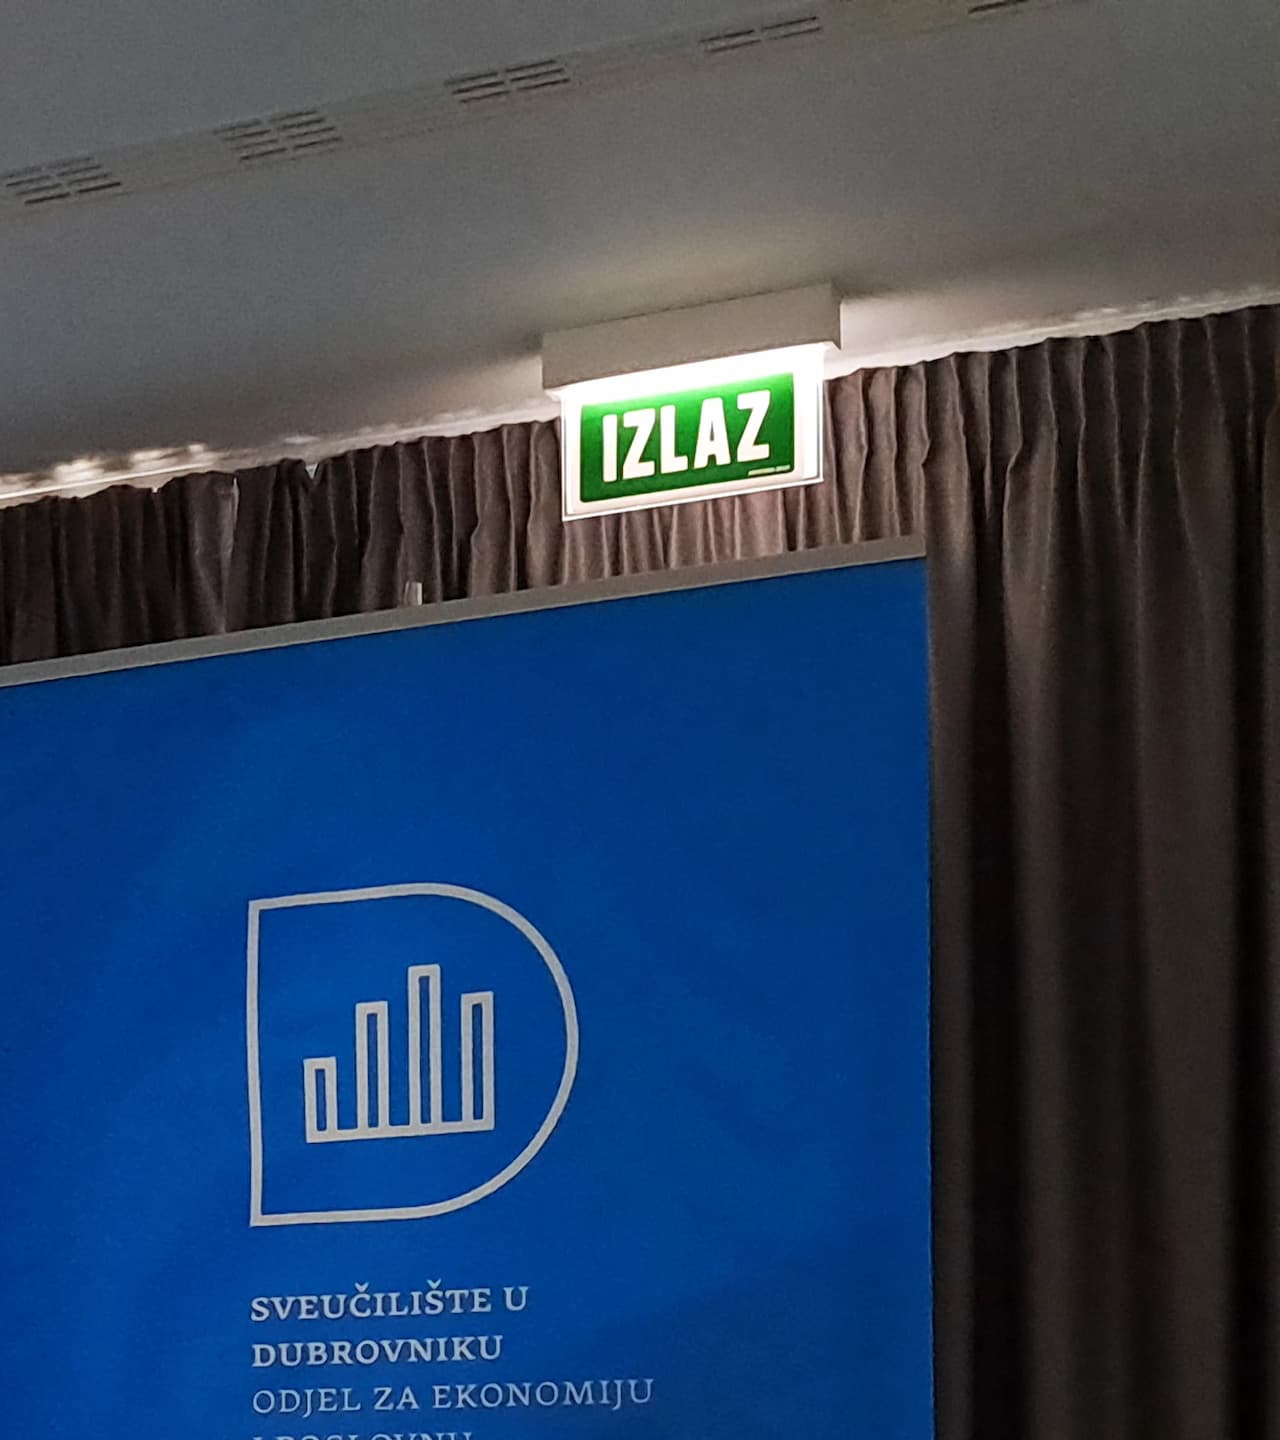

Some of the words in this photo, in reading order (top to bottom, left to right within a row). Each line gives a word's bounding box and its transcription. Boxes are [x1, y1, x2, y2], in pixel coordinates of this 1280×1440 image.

[602, 389, 771, 483] IZLAZ
[250, 1279, 492, 1322] SVEUČILIŠTE
[503, 1286, 529, 1311] U
[252, 1335, 503, 1367] DUBROVNIKU
[252, 1388, 361, 1418] ODJEL
[373, 1387, 420, 1410] ZA
[432, 1379, 654, 1410] EKONOMIJU
